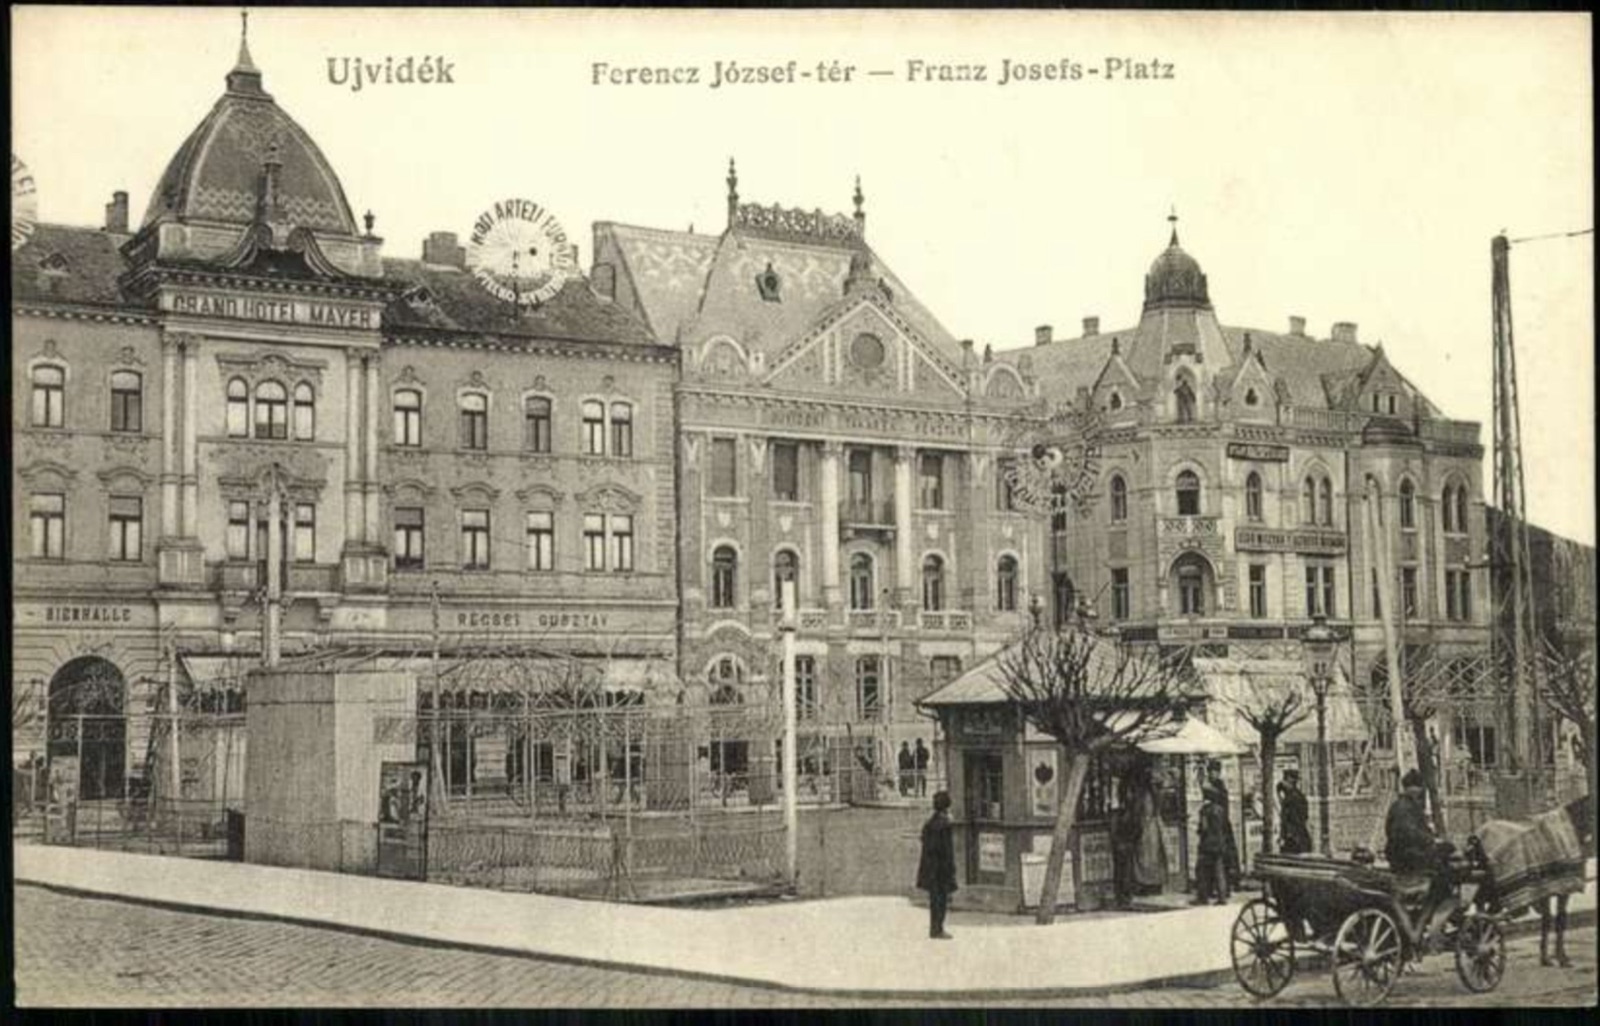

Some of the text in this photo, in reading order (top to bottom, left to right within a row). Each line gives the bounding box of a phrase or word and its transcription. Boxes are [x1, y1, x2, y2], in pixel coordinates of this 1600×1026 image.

[173, 294, 372, 329] GRAND HOTEL MAYER
